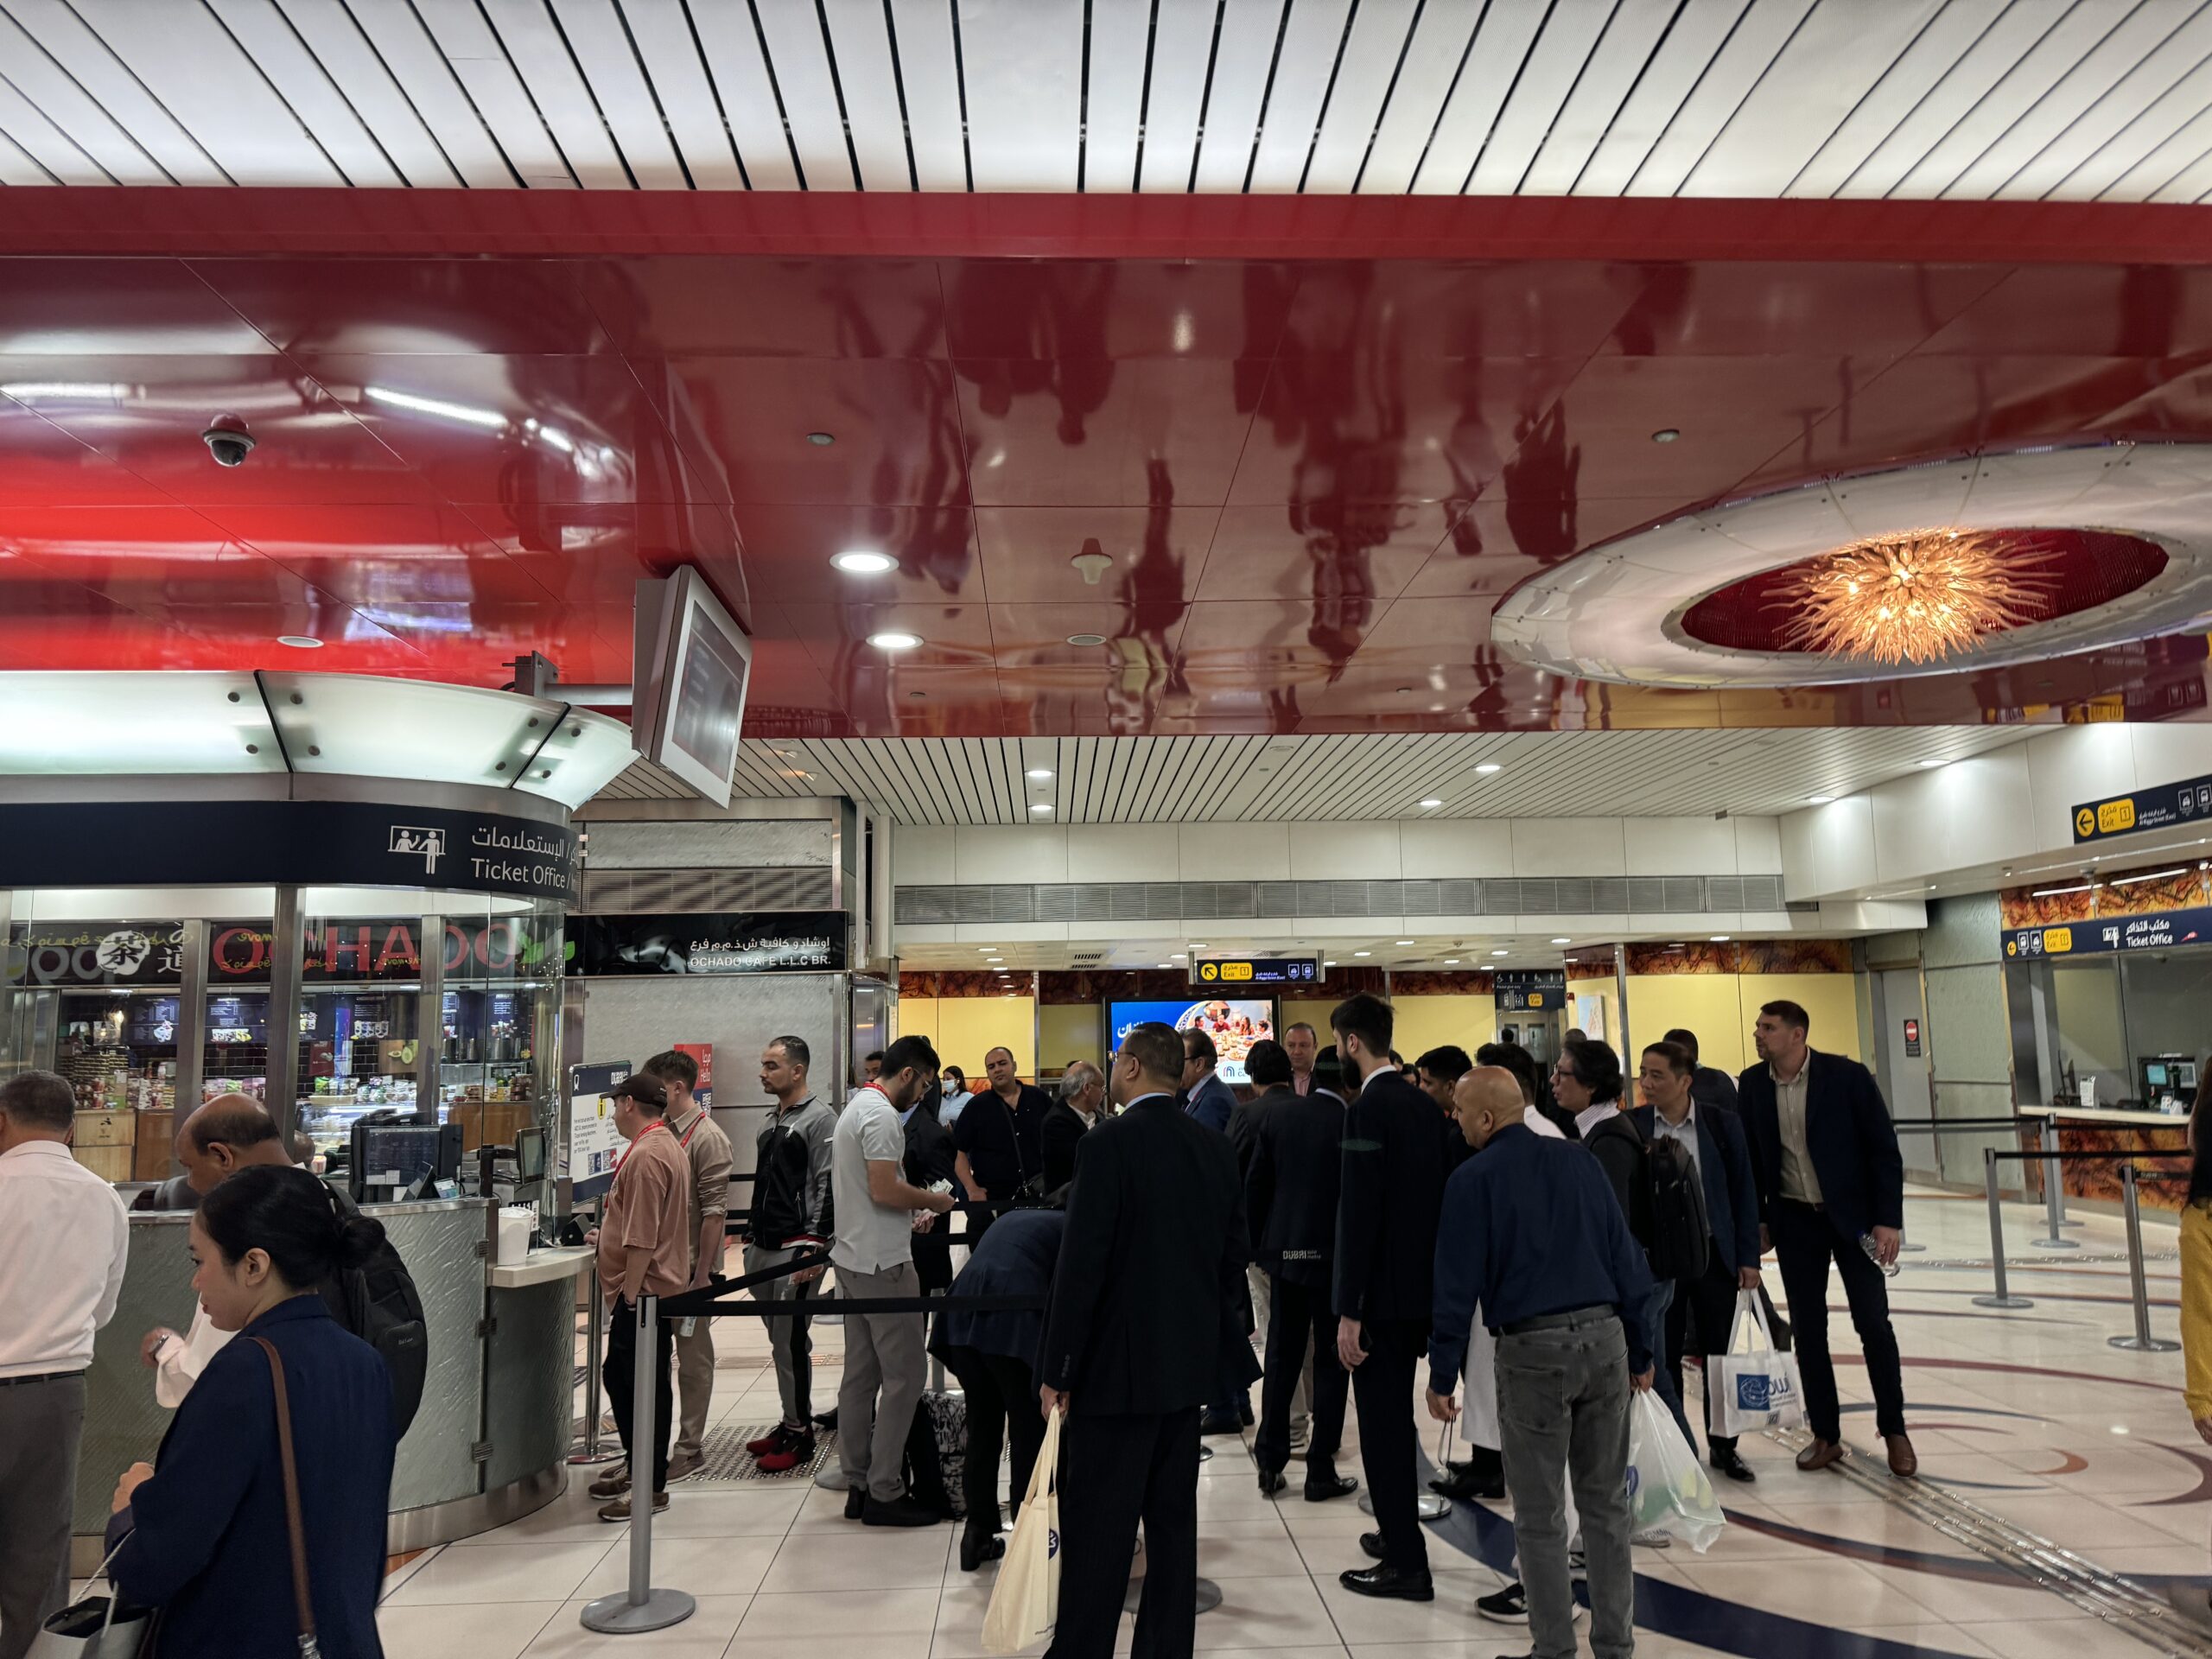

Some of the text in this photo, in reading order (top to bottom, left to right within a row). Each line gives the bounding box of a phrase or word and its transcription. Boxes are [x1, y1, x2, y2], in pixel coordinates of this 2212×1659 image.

[2102, 817, 2114, 829] Exit
[472, 827, 564, 861] الإستعلامات
[471, 858, 529, 883] Ticket
[533, 865, 565, 889] Office
[2149, 919, 2170, 931] مكتب
[690, 938, 709, 951] فرع
[2126, 934, 2150, 948] Ticket
[2150, 931, 2173, 945] Office
[690, 955, 832, 967] OCHADO CAFE L.L.C BR.
[700, 1067, 711, 1083] Hello
[1282, 1249, 1307, 1260] DUBAI
